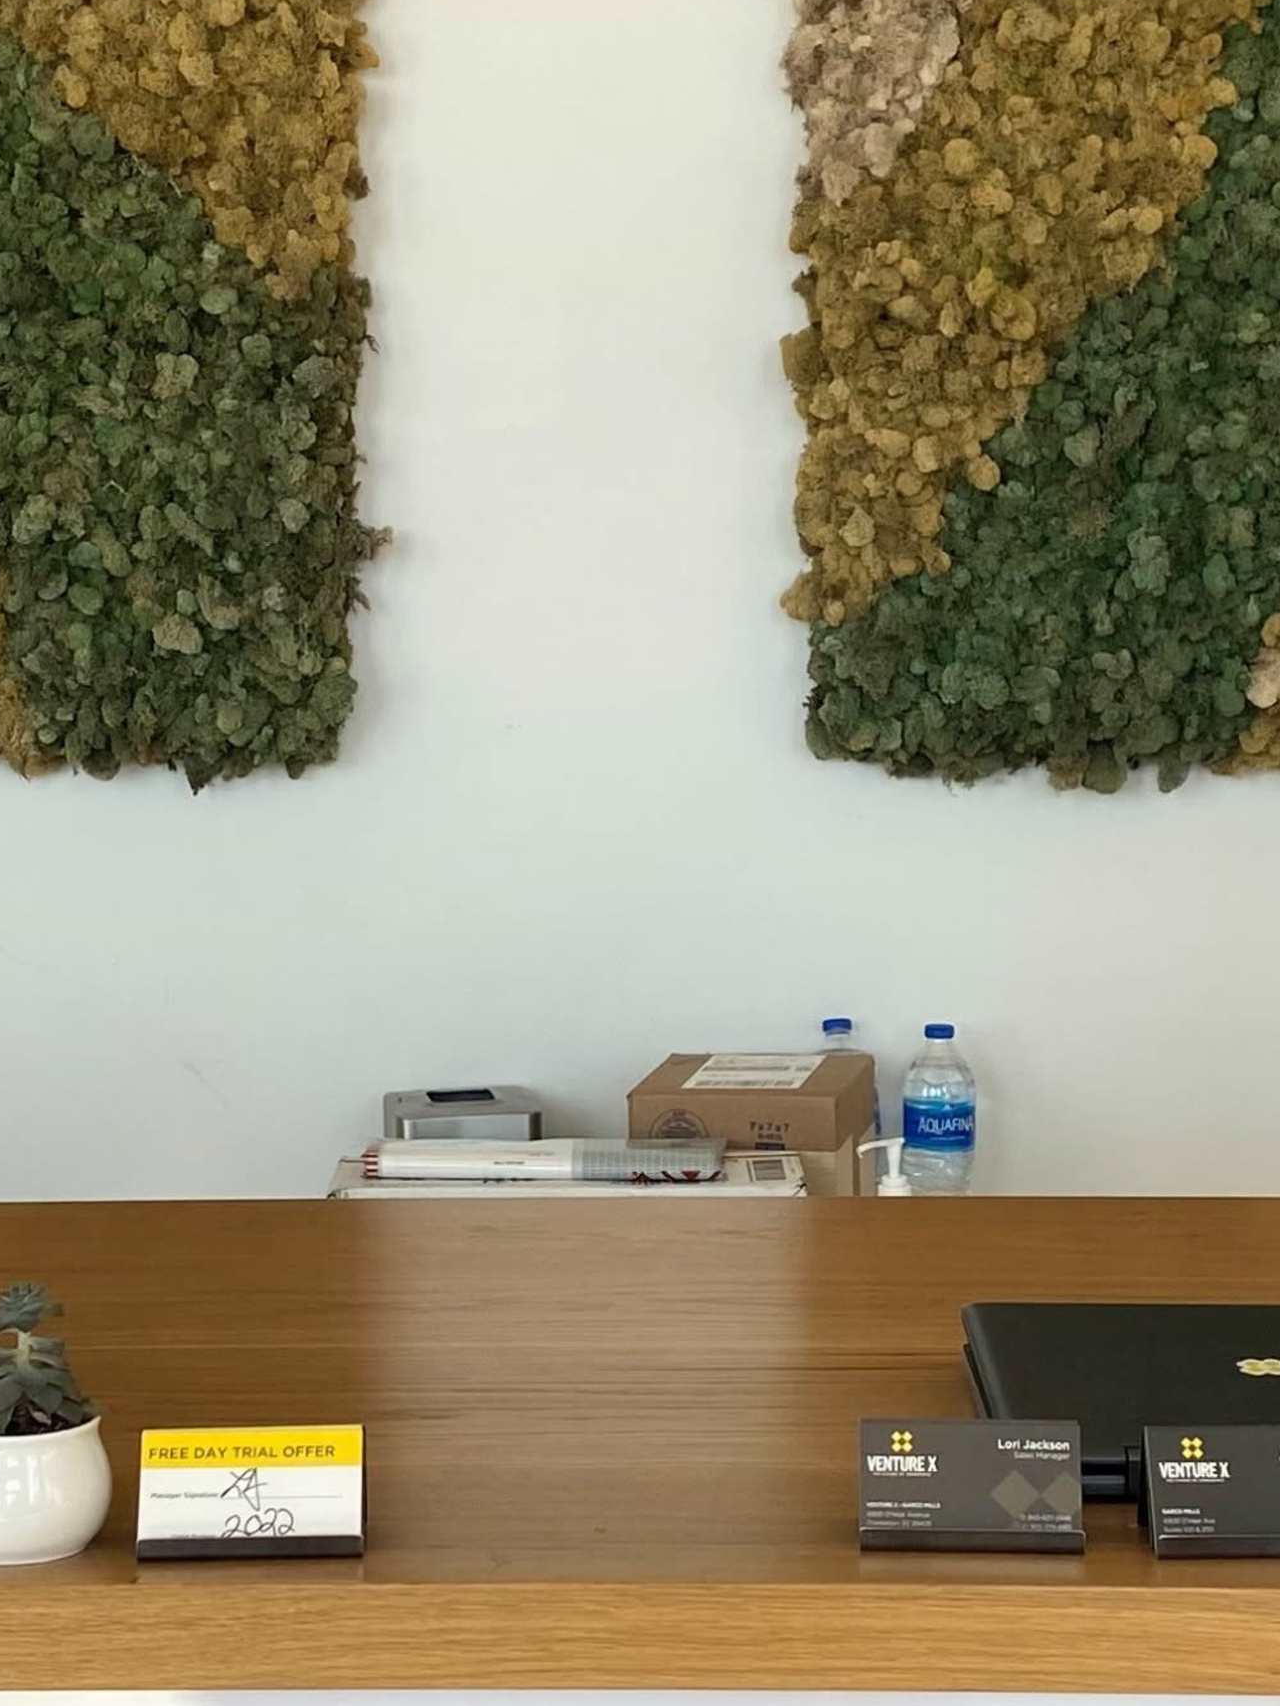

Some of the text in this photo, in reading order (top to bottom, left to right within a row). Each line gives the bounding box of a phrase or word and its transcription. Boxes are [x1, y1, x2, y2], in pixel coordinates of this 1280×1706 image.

[918, 1116, 974, 1135] AQUAFINA
[148, 1444, 336, 1460] FREE DAY TRIAL OFFER
[997, 1438, 1070, 1452] Lori Jackson
[866, 1455, 938, 1472] VENTURE X
[1036, 1452, 1070, 1462] Manager
[1158, 1461, 1231, 1479] VENTURE X
